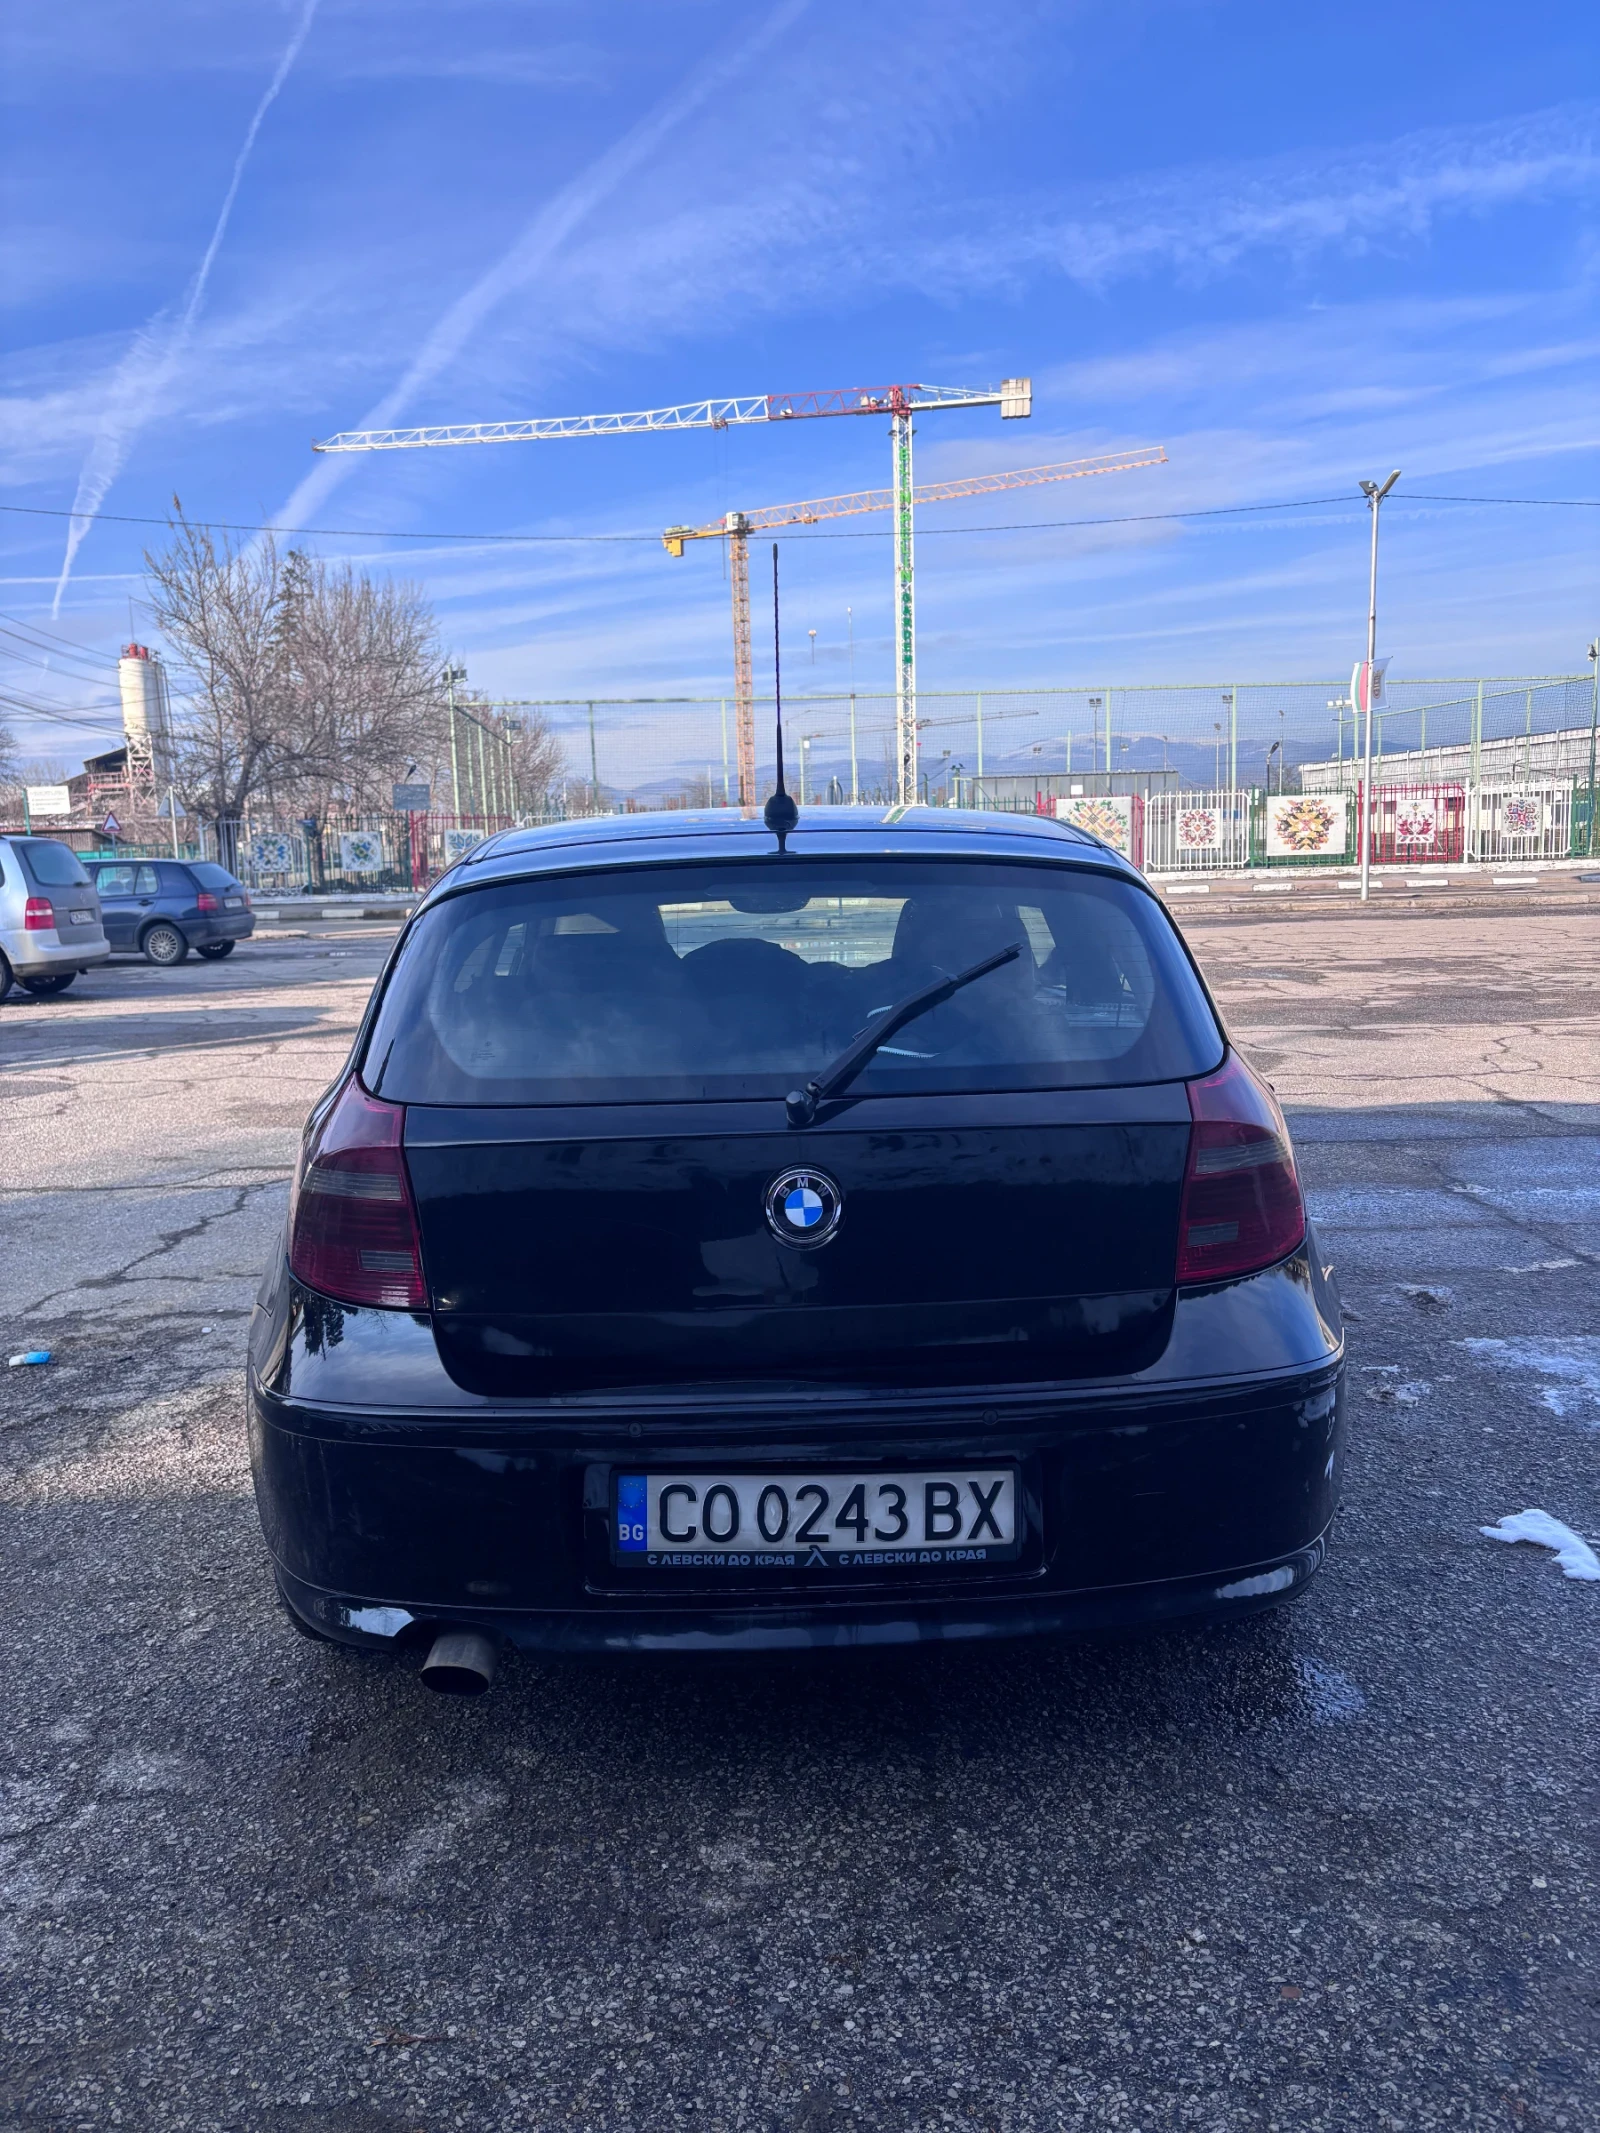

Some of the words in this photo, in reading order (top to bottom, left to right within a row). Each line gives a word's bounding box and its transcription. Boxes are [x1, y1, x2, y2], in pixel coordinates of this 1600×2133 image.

[900, 512, 911, 582] PELIN
[778, 1177, 829, 1198] BMW
[659, 1484, 739, 1543] CO
[757, 1483, 909, 1543] 0243
[924, 1480, 1005, 1541] BX
[618, 1524, 644, 1541] BG
[647, 1555, 657, 1565] С
[661, 1554, 725, 1566] ЛЕВСКИ
[727, 1555, 751, 1566] ДО
[754, 1554, 795, 1566] КРАЯ
[838, 1554, 849, 1565] С
[852, 1552, 917, 1565] ЛЕВСКИ
[919, 1551, 942, 1564] ДО
[945, 1549, 987, 1561] КРАЯ
